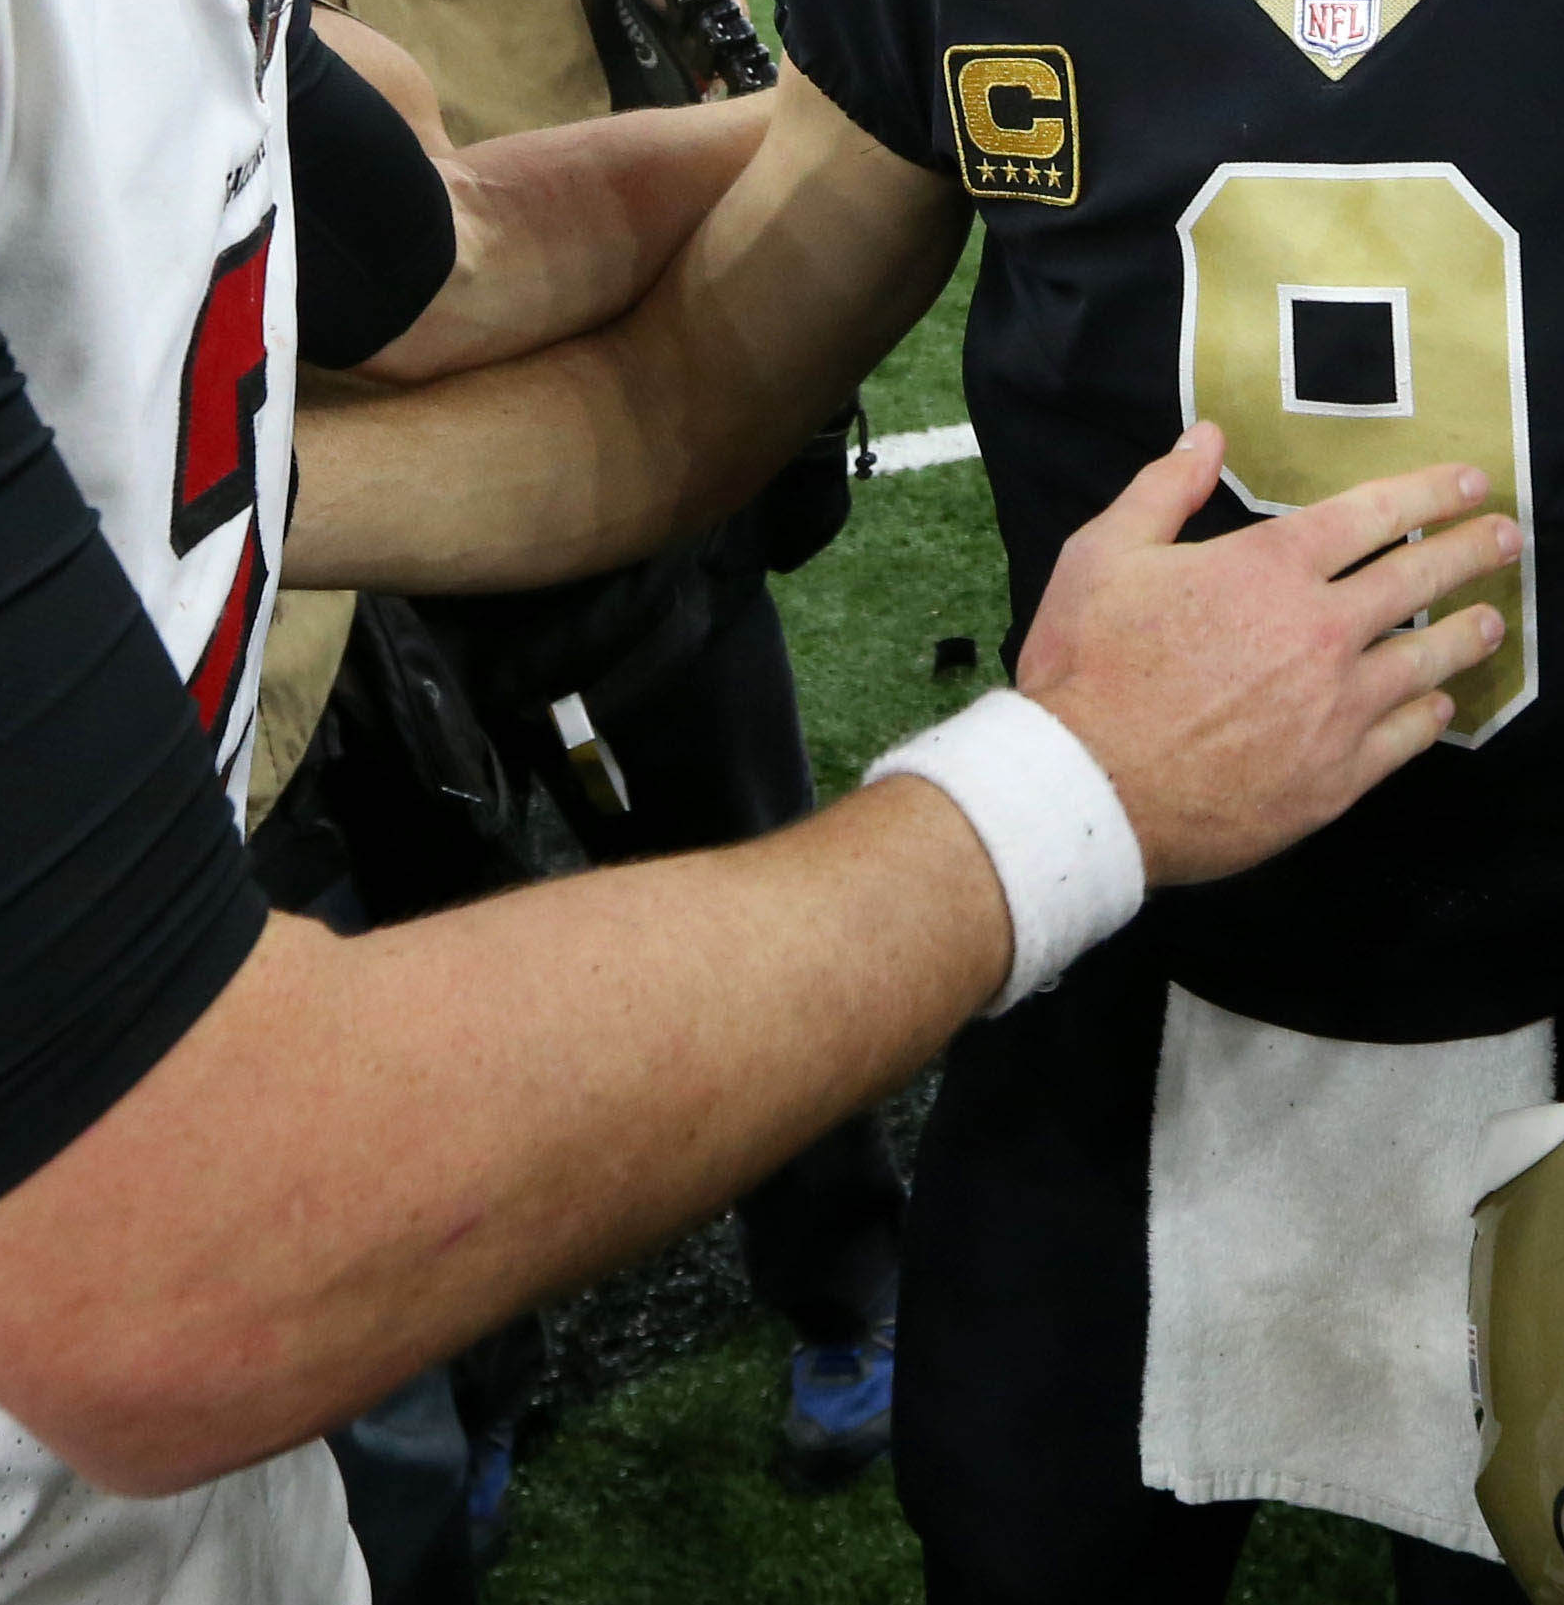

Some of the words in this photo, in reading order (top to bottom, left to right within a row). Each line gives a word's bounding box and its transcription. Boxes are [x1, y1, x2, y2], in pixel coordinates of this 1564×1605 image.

[1307, 1, 1365, 43] NFL
[958, 56, 1065, 160] C
[1176, 162, 1539, 751] 9
